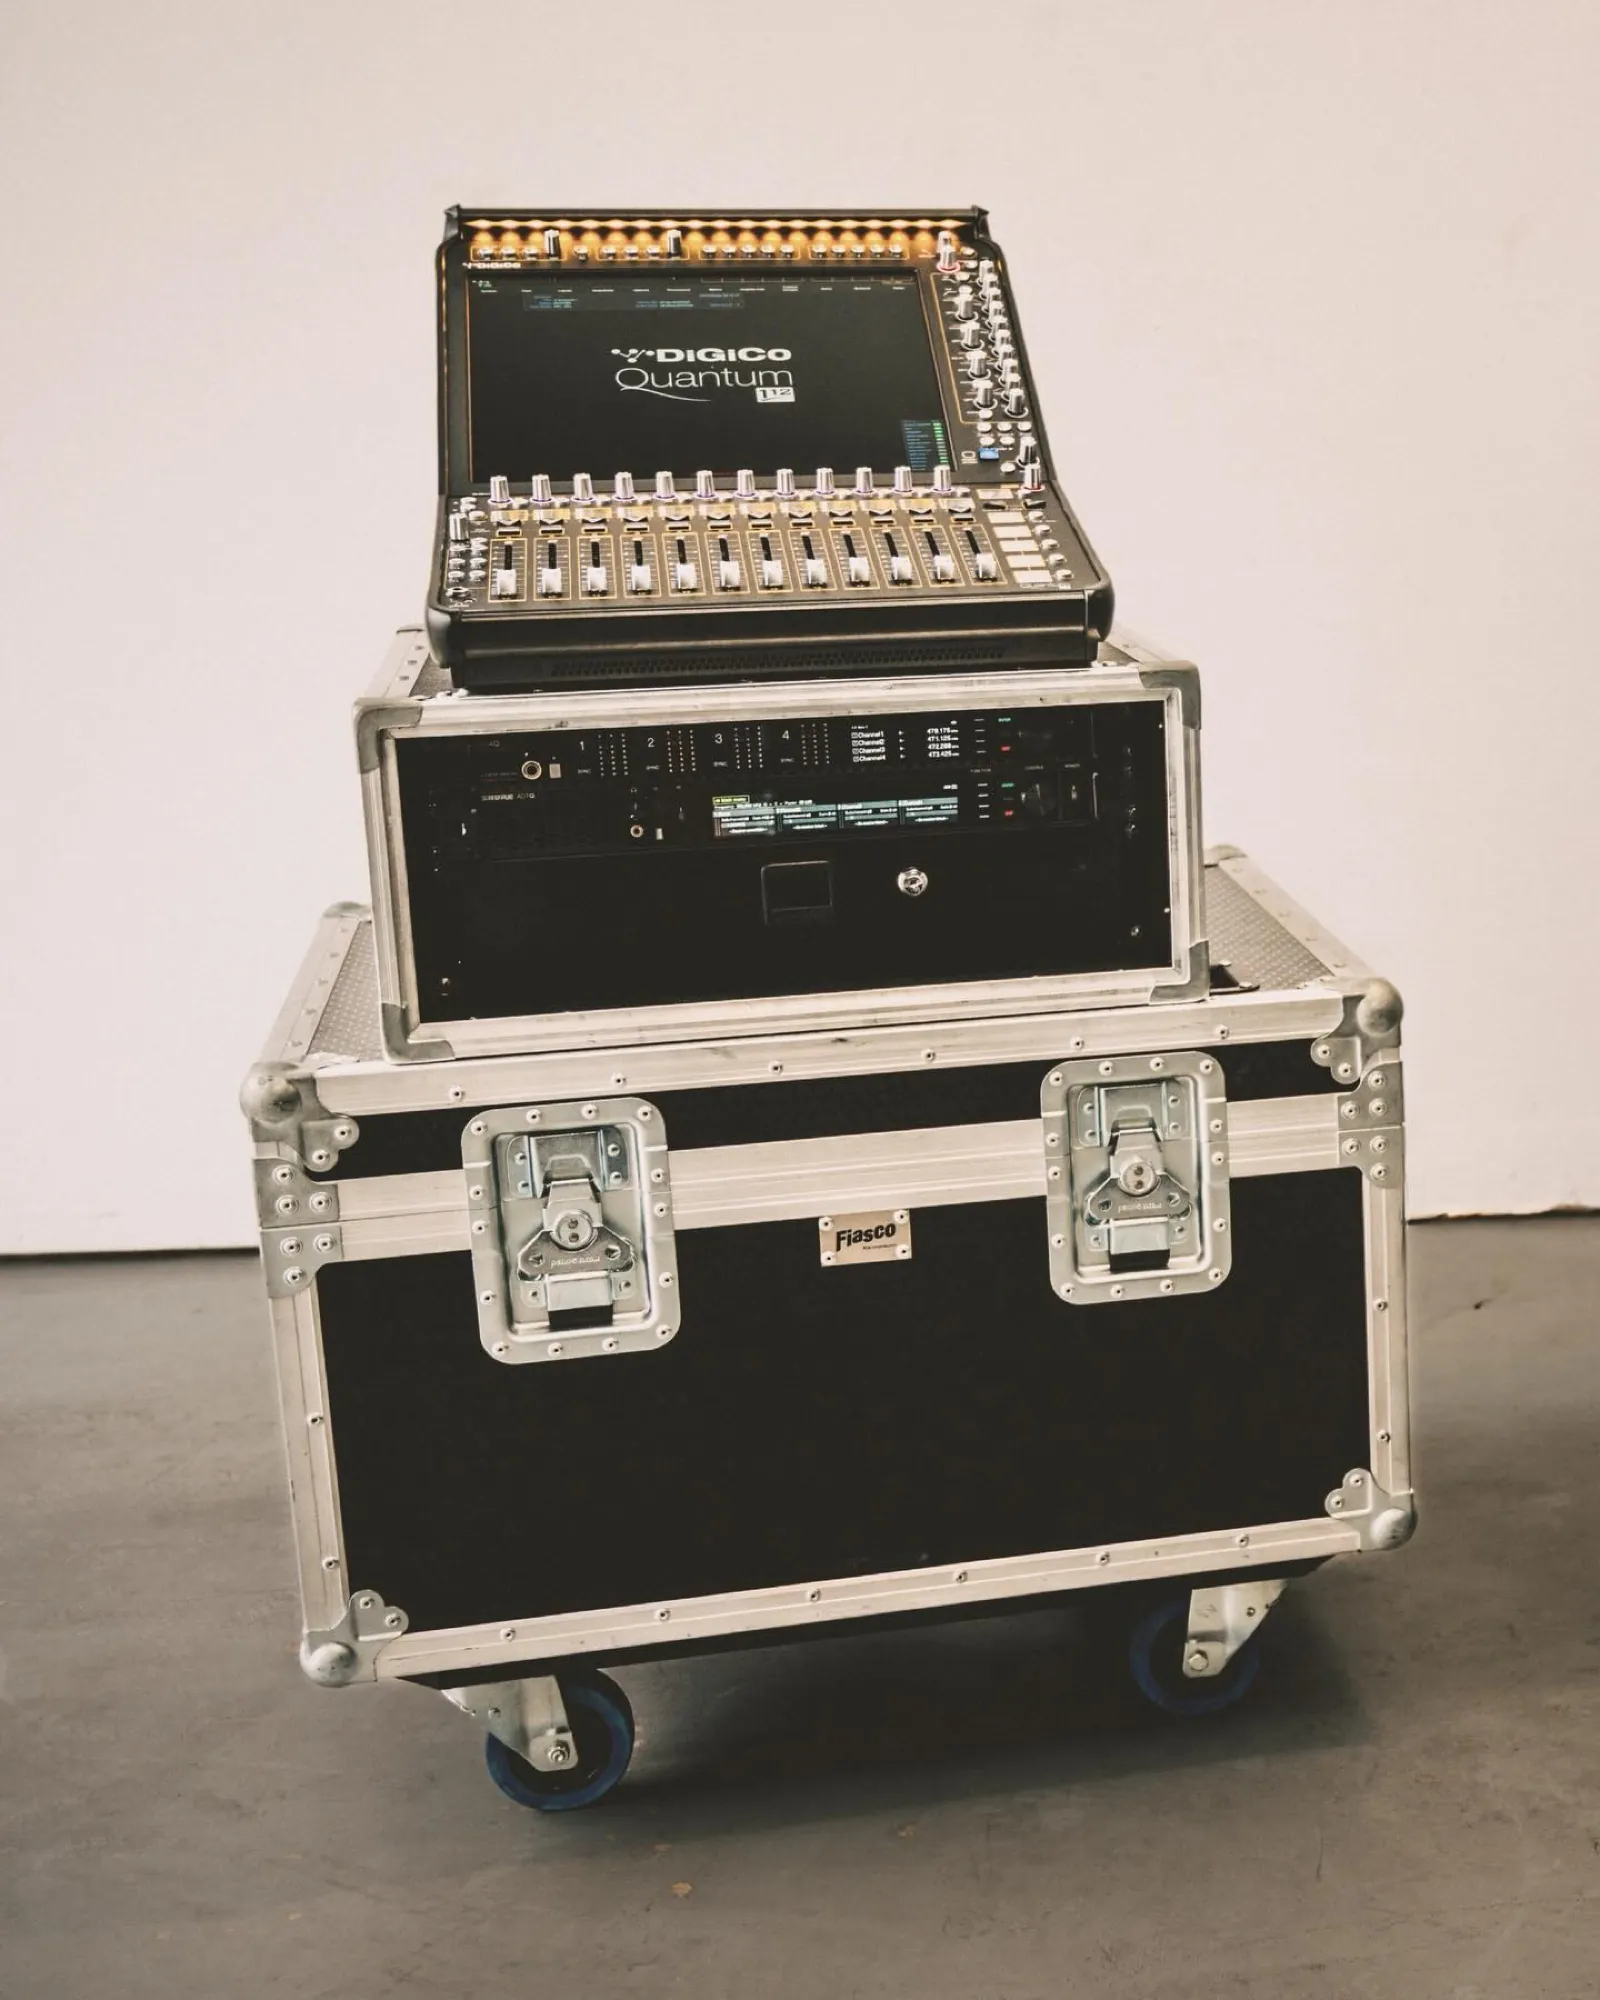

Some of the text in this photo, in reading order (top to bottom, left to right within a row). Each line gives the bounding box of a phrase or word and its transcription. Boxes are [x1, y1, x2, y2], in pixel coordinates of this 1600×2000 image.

[615, 367, 793, 401] Quantum
[758, 387, 794, 400] 112
[714, 733, 723, 744] 3
[782, 730, 790, 740] 4
[579, 740, 585, 751] 1
[647, 737, 655, 748] 2
[836, 1222, 896, 1252] Fiasco
